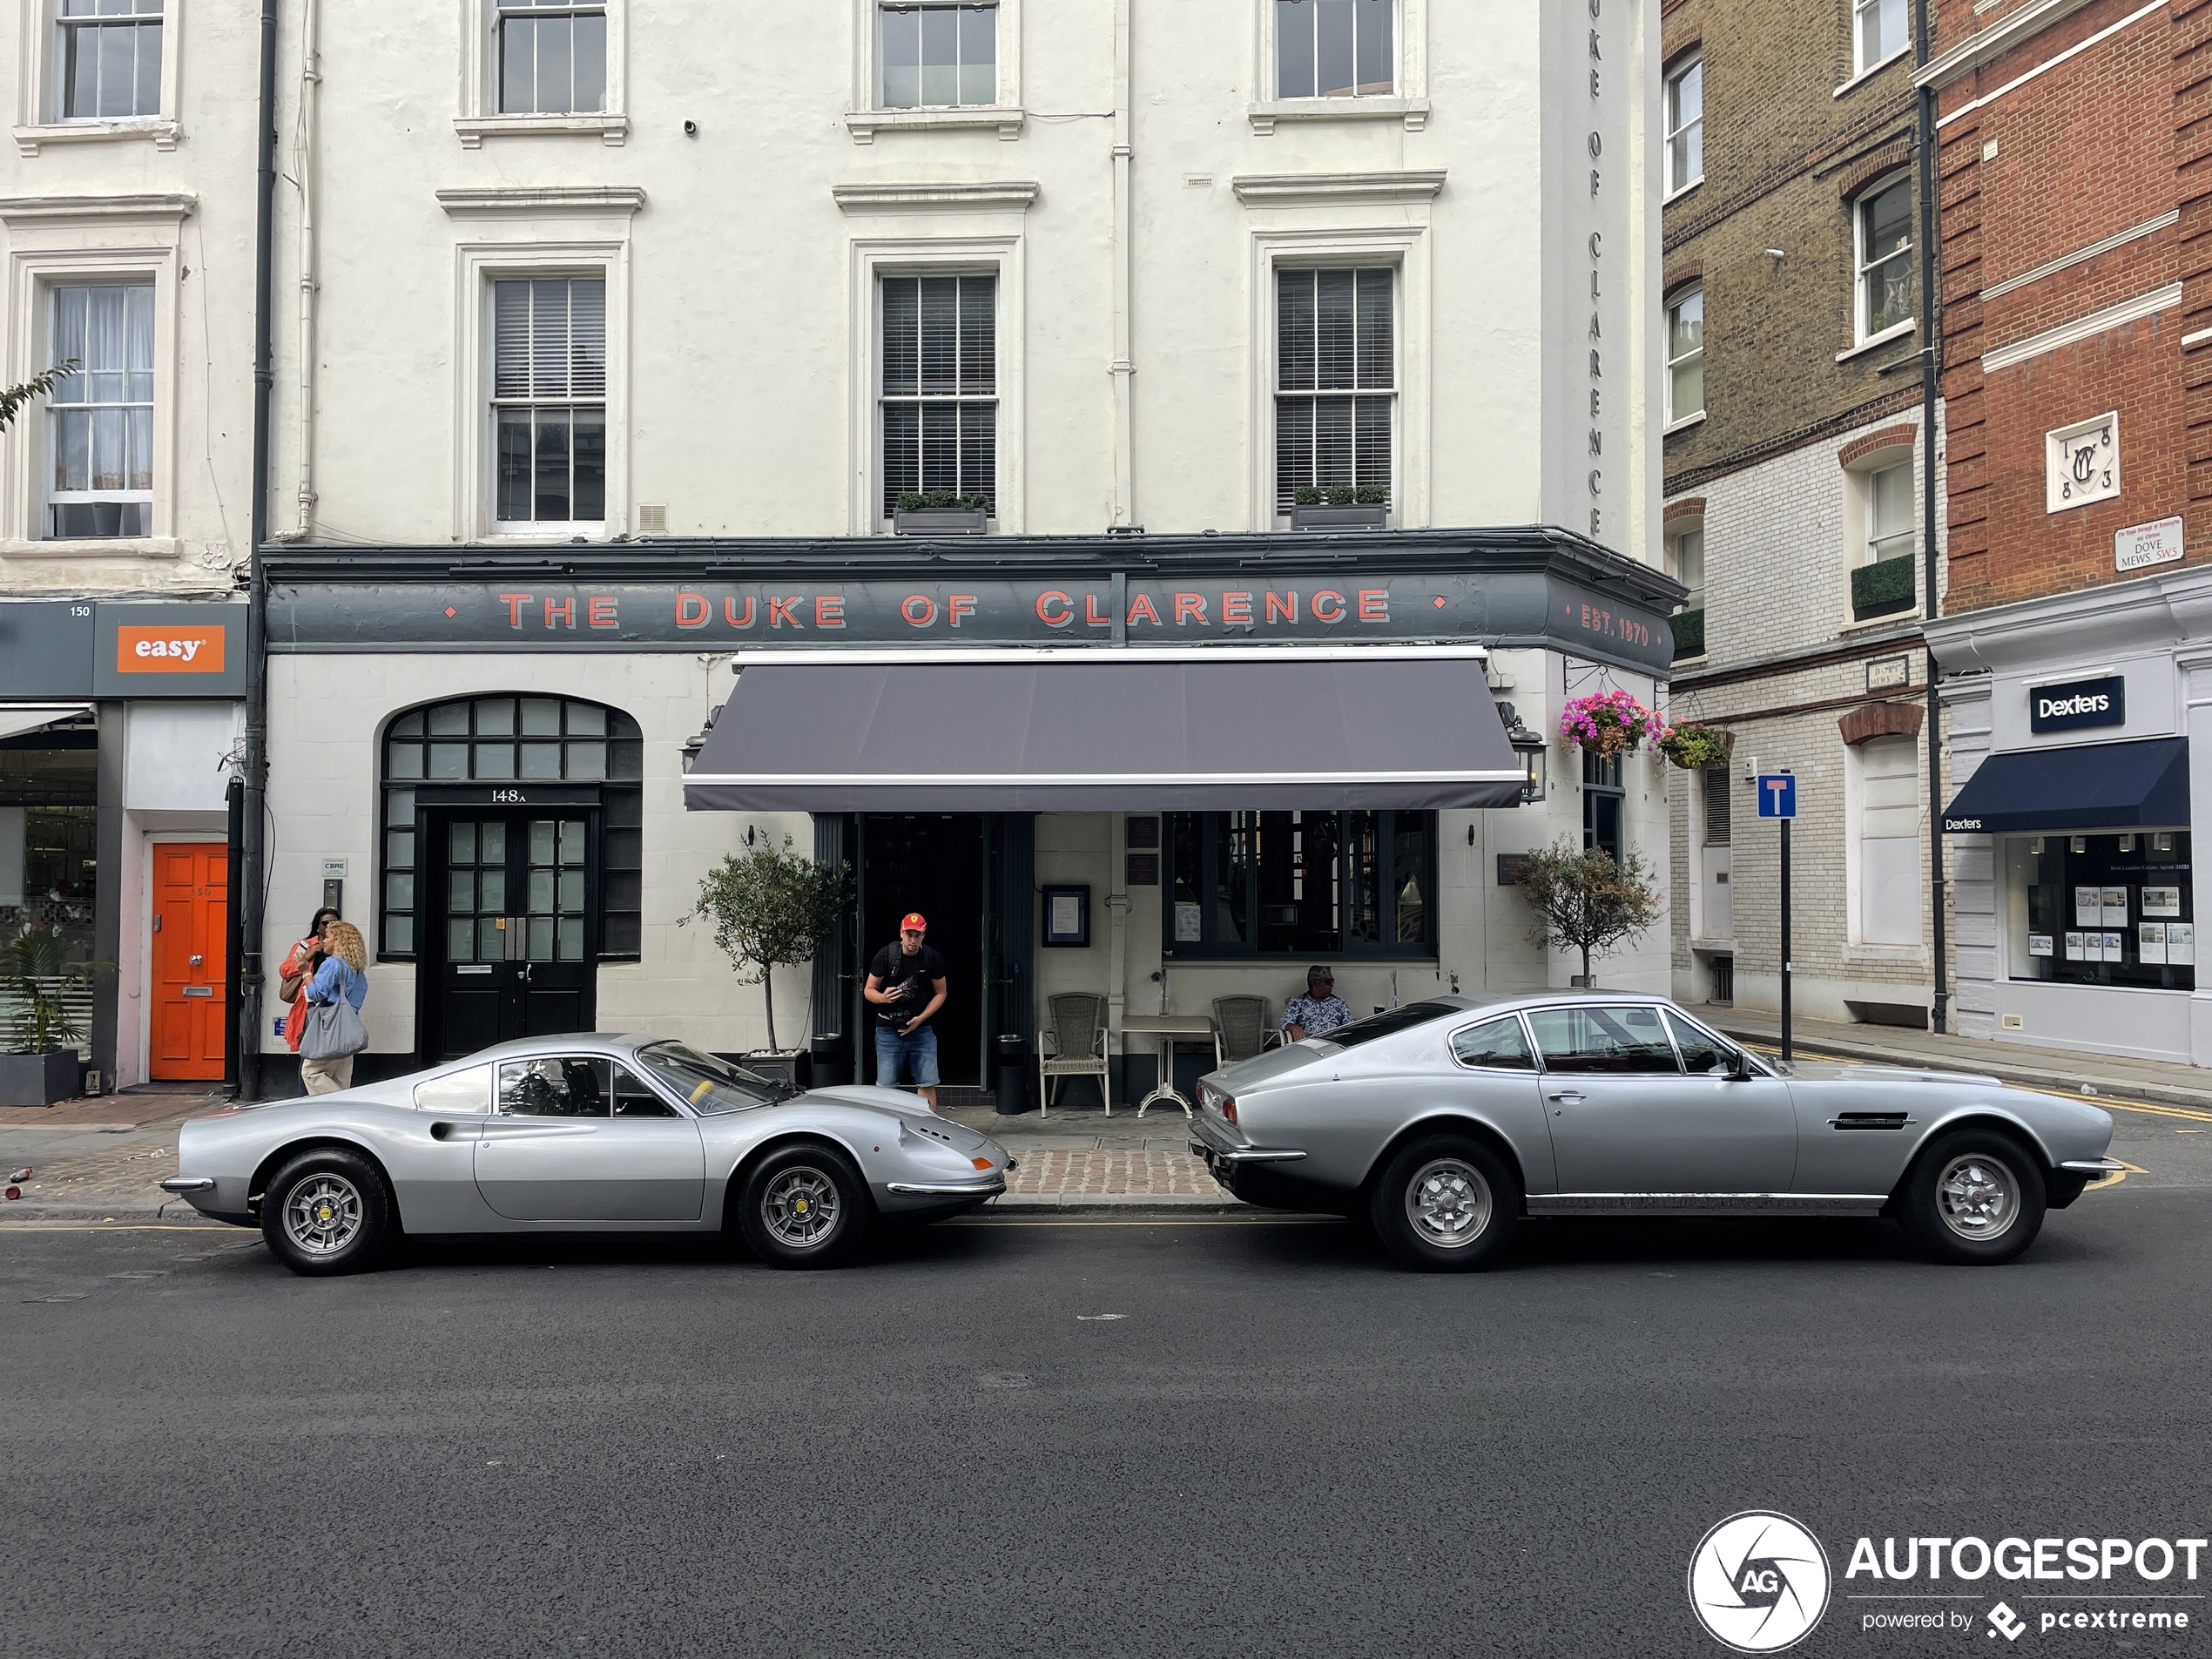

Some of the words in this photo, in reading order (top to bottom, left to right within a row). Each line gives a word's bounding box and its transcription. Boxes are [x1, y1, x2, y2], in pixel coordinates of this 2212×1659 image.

[1588, 0, 1602, 97] UKE
[1588, 131, 1602, 197] OF
[1588, 232, 1602, 534] CLARENCE
[2135, 539, 2162, 554] DOVE
[71, 606, 90, 617] 150
[499, 593, 619, 630] THE
[675, 592, 847, 630] DUKE
[900, 594, 979, 629] OF
[1035, 589, 1391, 629] CLARENCE
[1581, 604, 1615, 637] EST.
[1619, 617, 1649, 647] 1870
[2040, 694, 2109, 718] Dexters
[1946, 818, 1982, 830] Dexters
